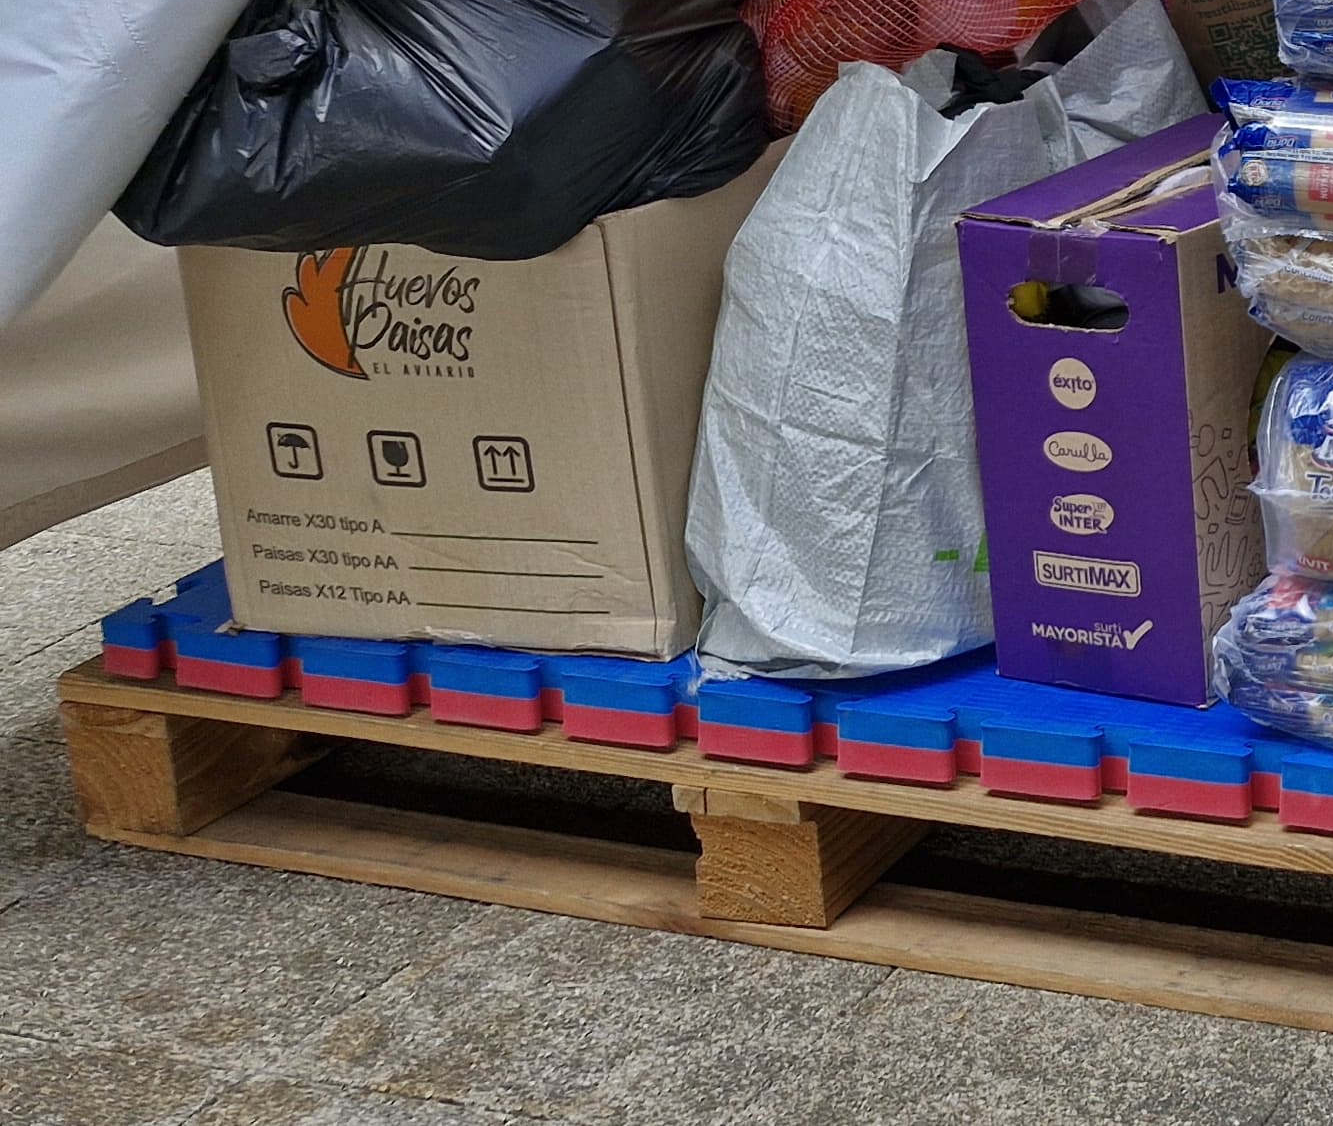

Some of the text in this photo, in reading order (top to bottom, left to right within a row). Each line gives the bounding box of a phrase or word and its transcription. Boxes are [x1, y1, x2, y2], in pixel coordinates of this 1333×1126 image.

[335, 248, 480, 320] Huevos
[347, 295, 473, 366] Paisas
[373, 362, 475, 378] EL AVIARIO
[1053, 374, 1093, 393] éxito
[1048, 440, 1109, 462] Carulla
[1053, 497, 1092, 515] Super
[247, 509, 385, 534] Amarre X30 tipo A
[1058, 513, 1104, 532] INTER
[252, 544, 399, 570] Paisas X30 tipo AA
[1042, 563, 1131, 589] SURTIMAX
[259, 579, 411, 605] Paisas X12 Tipo AA
[1031, 623, 1124, 650] MAYORISTA
[1094, 622, 1122, 635] surti
